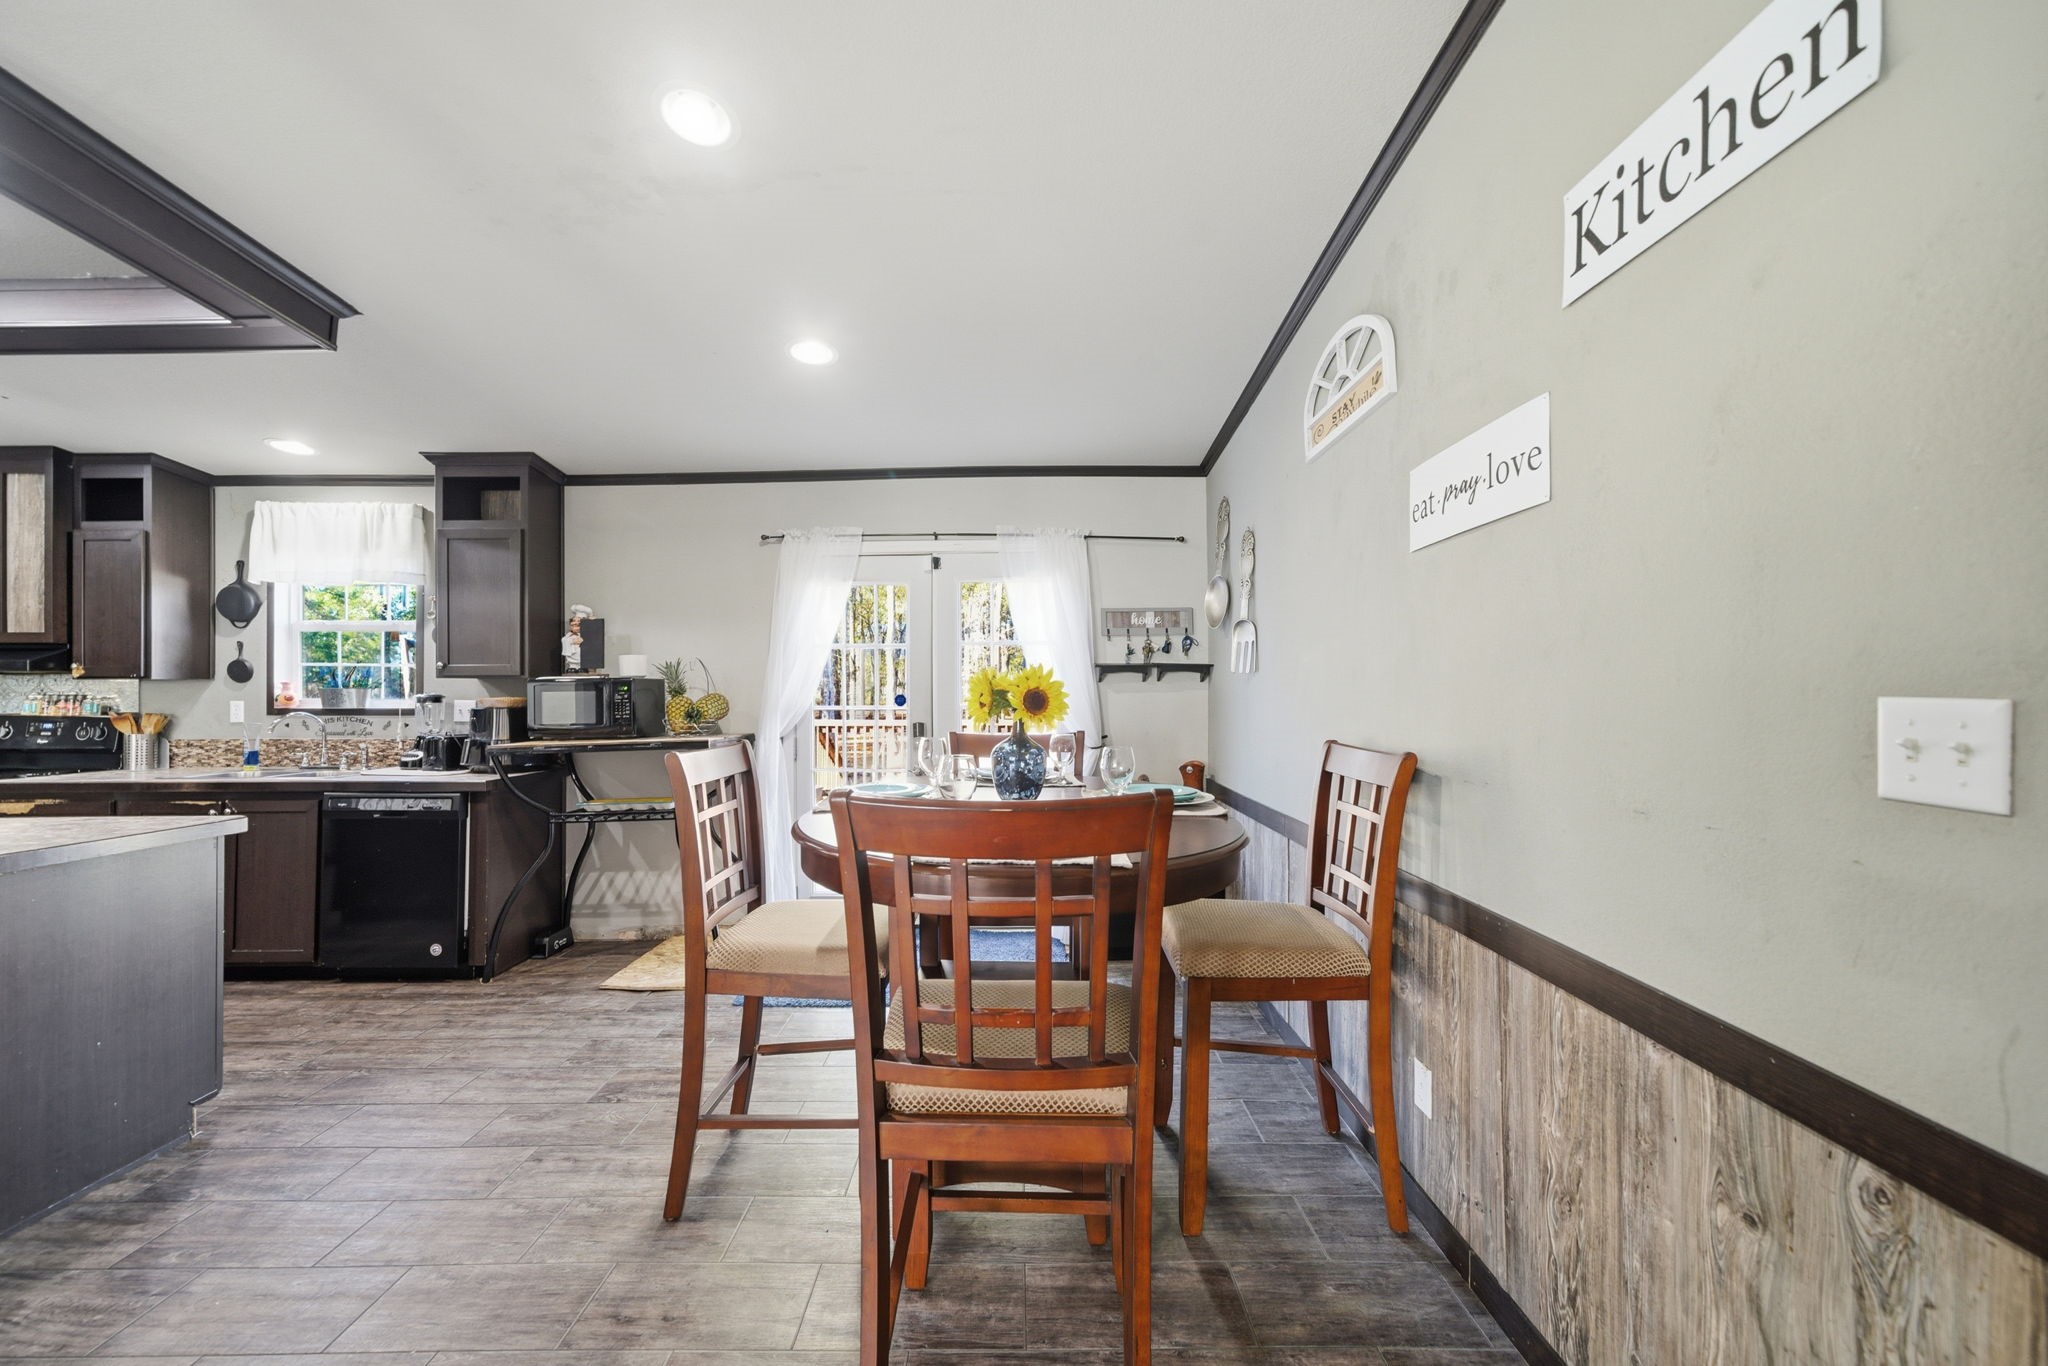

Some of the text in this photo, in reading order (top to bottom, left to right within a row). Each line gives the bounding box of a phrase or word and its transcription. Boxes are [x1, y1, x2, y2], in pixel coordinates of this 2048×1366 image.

[1570, 0, 1867, 278] Kitchen
[1332, 392, 1356, 424] STAY
[1131, 612, 1163, 625] home
[336, 716, 374, 727] KITCHEN
